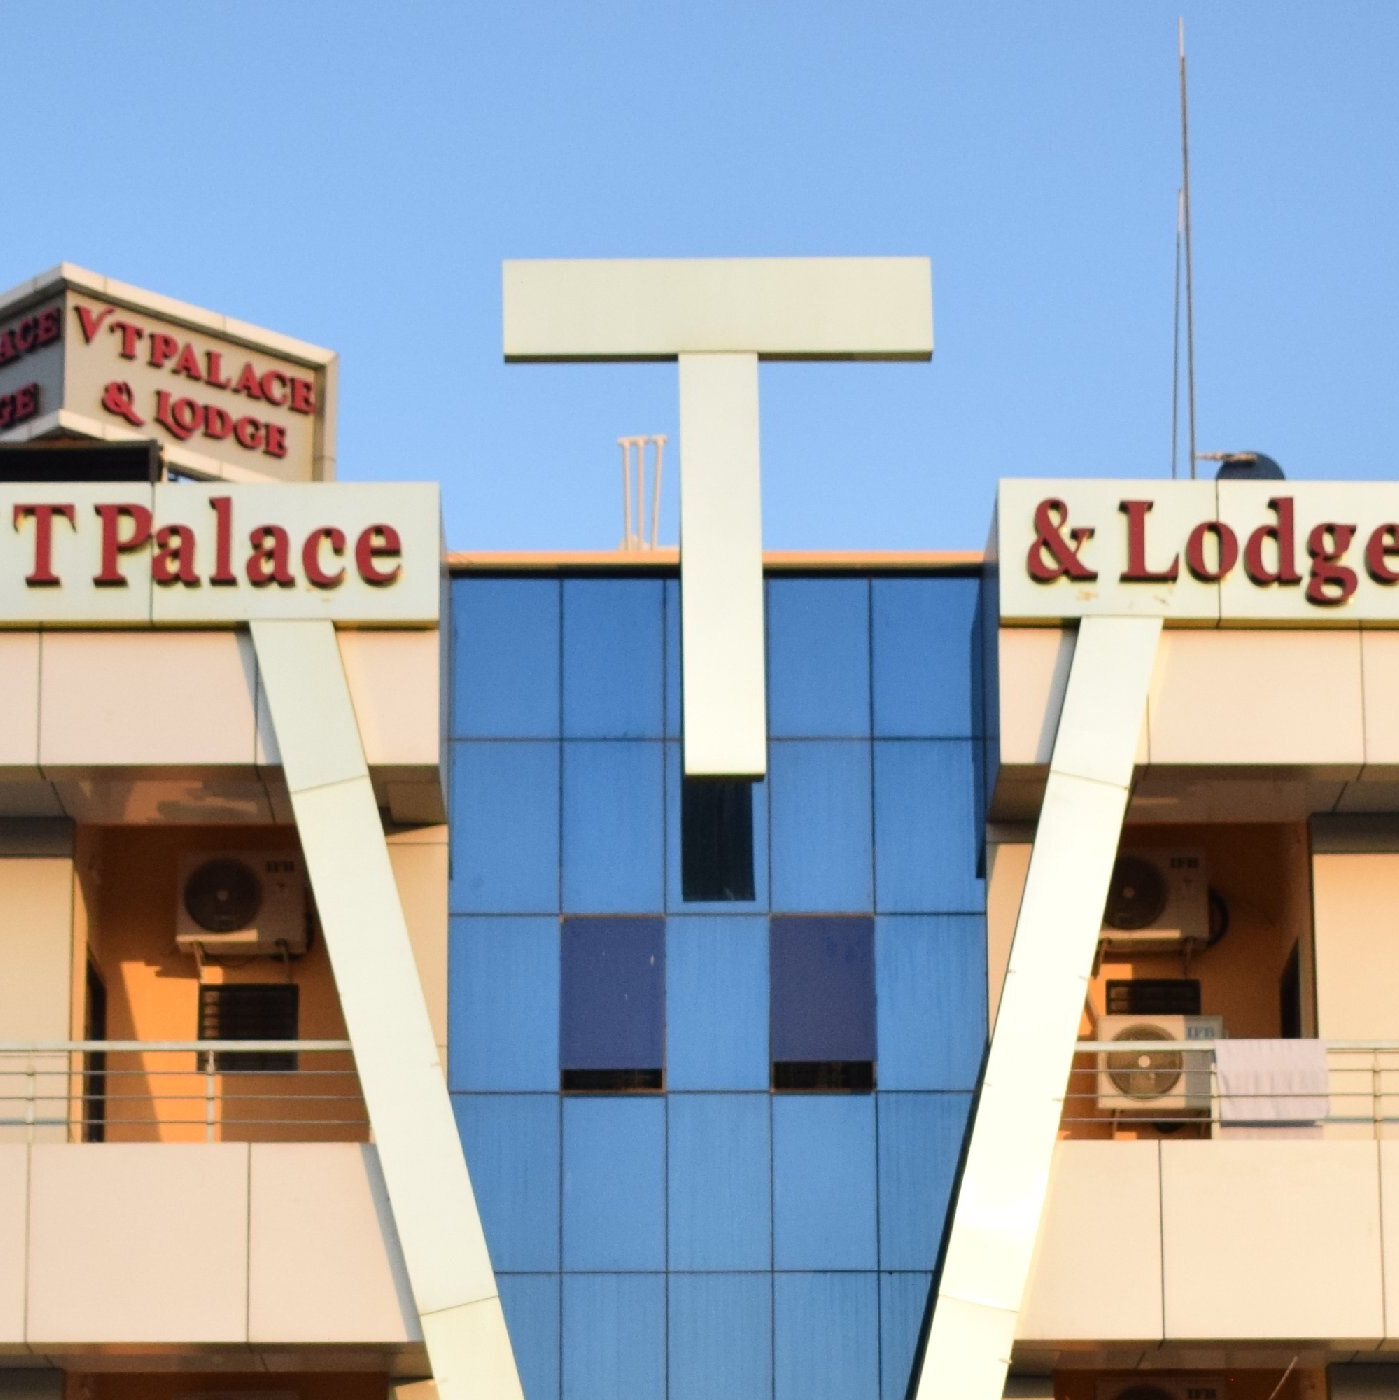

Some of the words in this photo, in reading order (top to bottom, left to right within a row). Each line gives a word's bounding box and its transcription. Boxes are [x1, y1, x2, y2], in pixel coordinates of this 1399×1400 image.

[100, 379, 144, 427] &
[153, 387, 288, 460] LODGE
[91, 496, 404, 588] Palace
[1026, 496, 1099, 585] &
